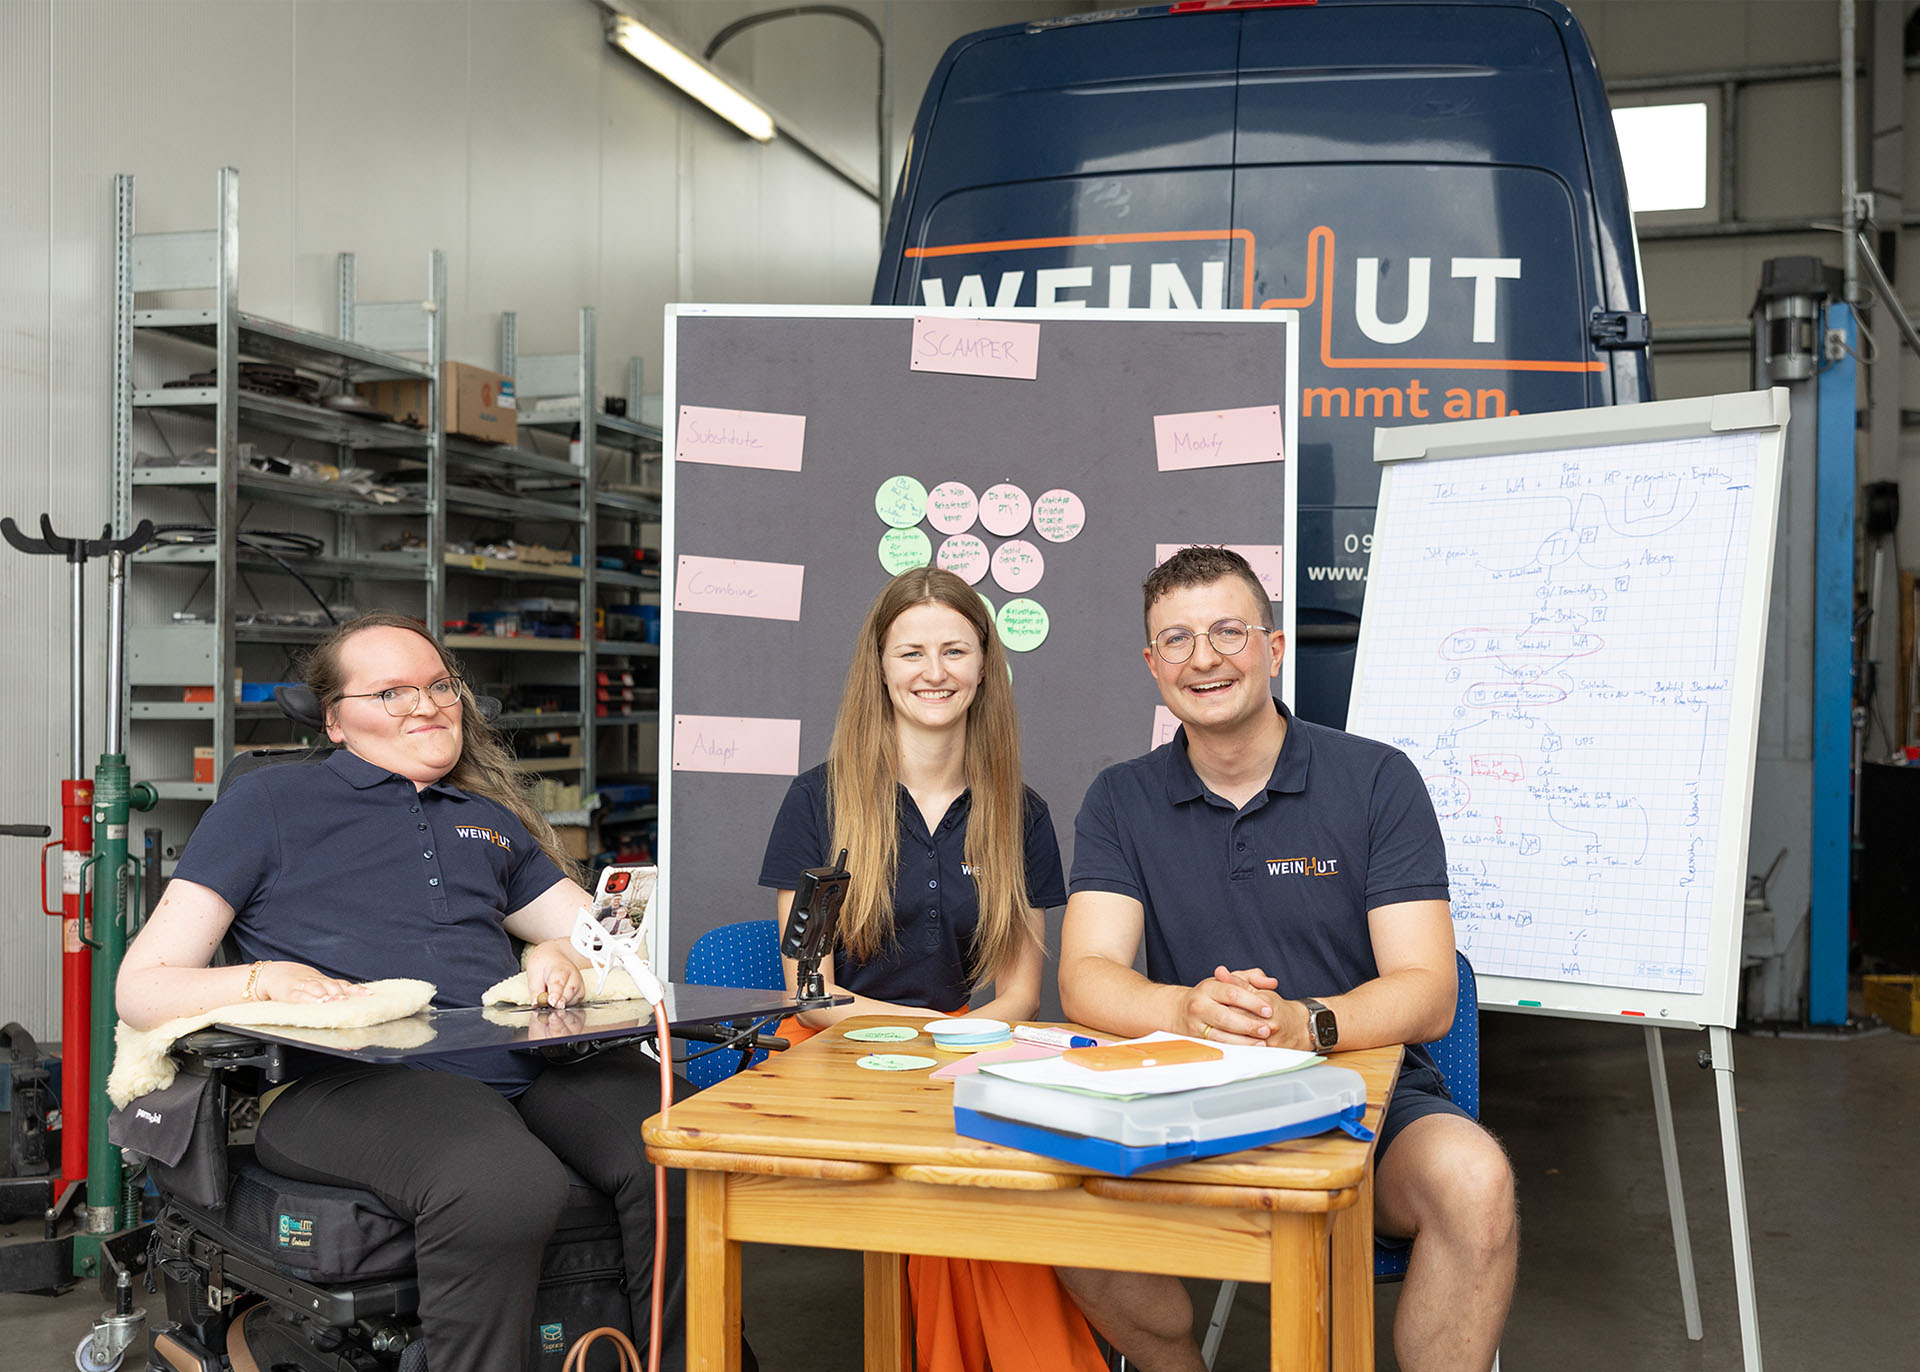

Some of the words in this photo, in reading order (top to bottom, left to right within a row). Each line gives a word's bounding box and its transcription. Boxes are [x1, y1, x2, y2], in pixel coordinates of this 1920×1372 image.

[918, 331, 1018, 362] SCAMPER
[1443, 387, 1520, 419] an.
[686, 420, 764, 448] Substitute
[1173, 431, 1223, 456] Modify
[1344, 534, 1374, 554] 09
[688, 571, 757, 599] Combine
[1307, 566, 1368, 582] www.
[691, 732, 740, 767] Adapt
[455, 825, 511, 852] WEINHUT
[1266, 857, 1338, 876] WEINHUT
